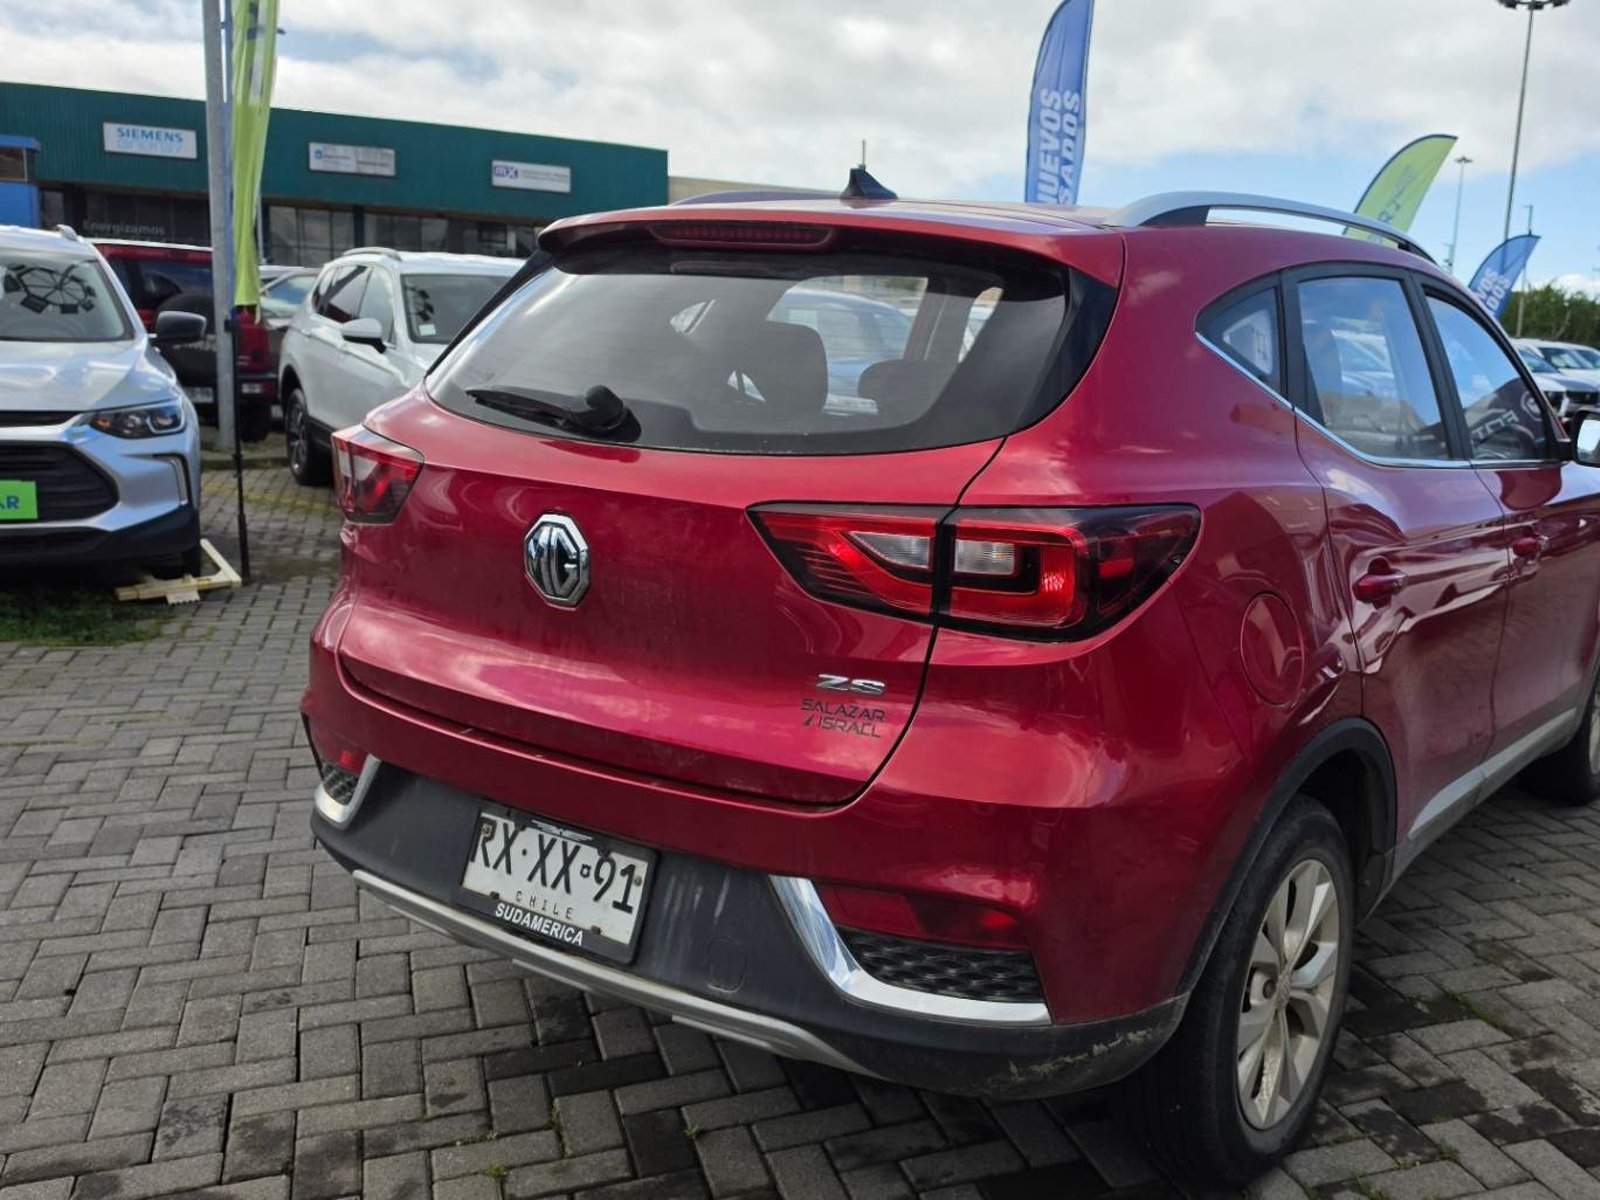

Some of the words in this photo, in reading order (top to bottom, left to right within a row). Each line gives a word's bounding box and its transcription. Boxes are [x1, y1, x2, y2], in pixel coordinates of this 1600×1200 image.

[116, 127, 184, 143] SIEMENS
[527, 524, 579, 597] MG
[816, 673, 886, 695] ZS
[800, 698, 886, 722] SALAZAR
[515, 890, 574, 921] CHILE
[495, 902, 585, 947] SUDAMERICA
